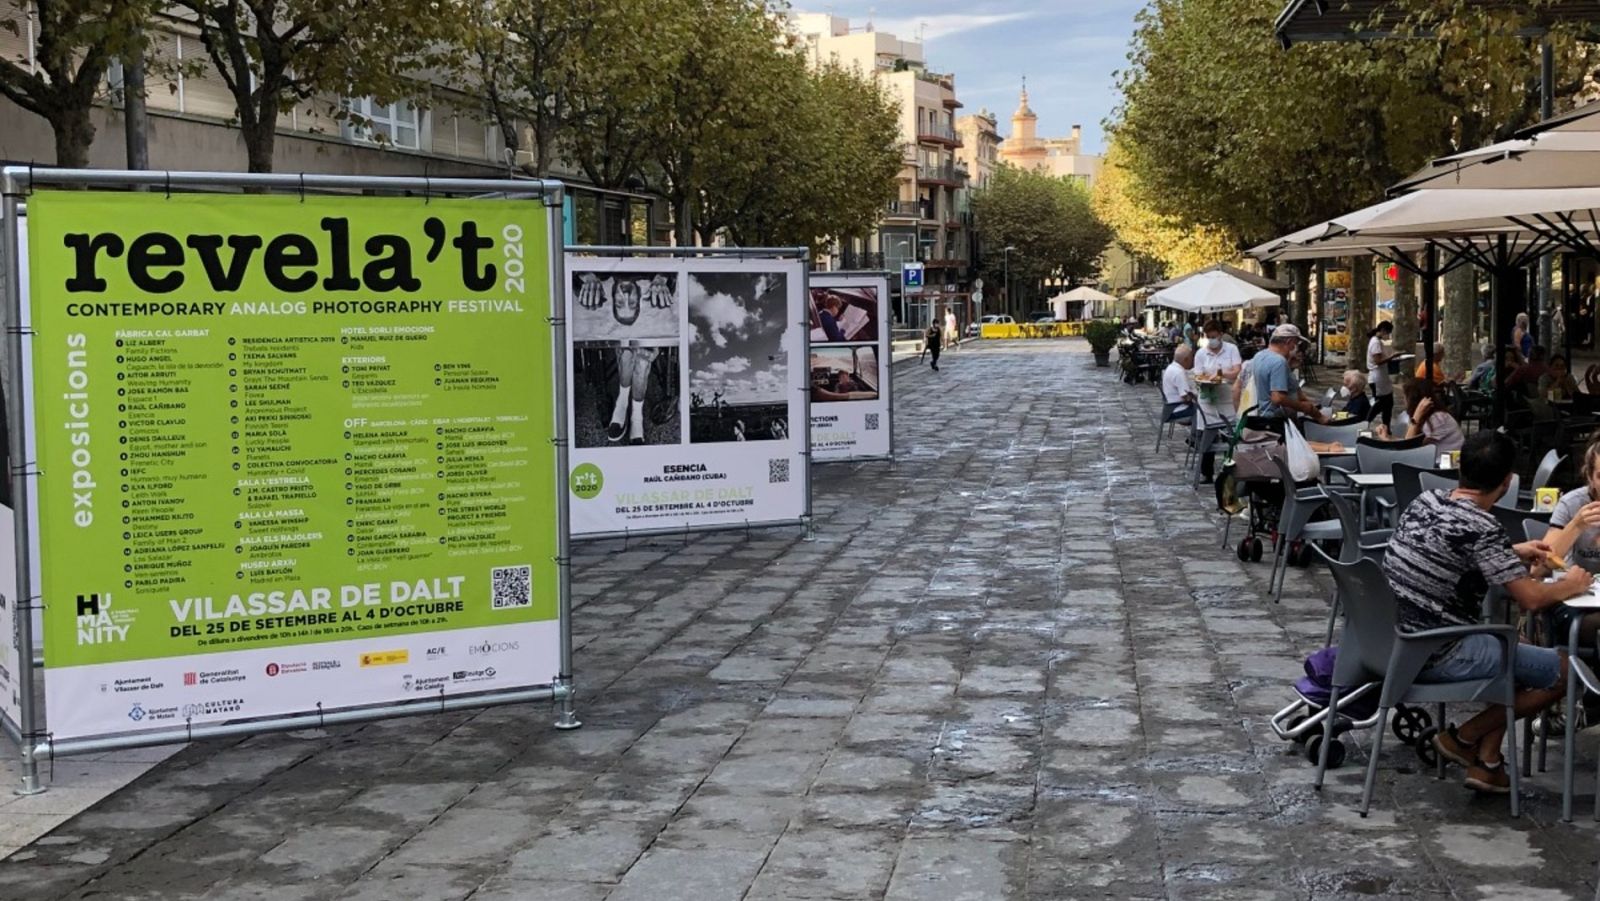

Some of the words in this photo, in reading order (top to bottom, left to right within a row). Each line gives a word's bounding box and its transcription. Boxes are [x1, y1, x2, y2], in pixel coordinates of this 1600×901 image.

[64, 217, 498, 293] revela't
[503, 223, 524, 293] 2020
[909, 270, 916, 280] P
[67, 302, 226, 317] CONTEMPORARY
[230, 301, 306, 315] ANALOG
[313, 300, 443, 314] PHOTOGRAPHY
[448, 299, 524, 313] FESTIVAL
[344, 418, 367, 428] OFF
[64, 332, 96, 527] exposicions
[664, 464, 707, 474] ESENCIA
[644, 475, 662, 483] RAÚL
[702, 472, 726, 480] (CUBA)
[616, 490, 692, 504] VILASSAR
[696, 489, 714, 500] DE
[719, 486, 754, 499] DALT
[655, 503, 693, 511] SETEMBRE
[713, 500, 754, 508] D'OCTUBRE
[240, 536, 261, 544] SALA
[170, 587, 332, 622] VILASSAR
[341, 583, 382, 608] DE
[391, 576, 465, 604] DALT
[170, 623, 201, 637] DEL
[207, 621, 224, 634] 25
[230, 619, 250, 632] DE
[255, 612, 337, 630] SETEMBRE
[342, 610, 361, 622] AL
[366, 609, 374, 620] 4
[379, 601, 464, 619] D'OCTUBRE
[426, 647, 446, 655] AC/E
[200, 670, 239, 678] Generalitat
[205, 699, 244, 708] CULTURA
